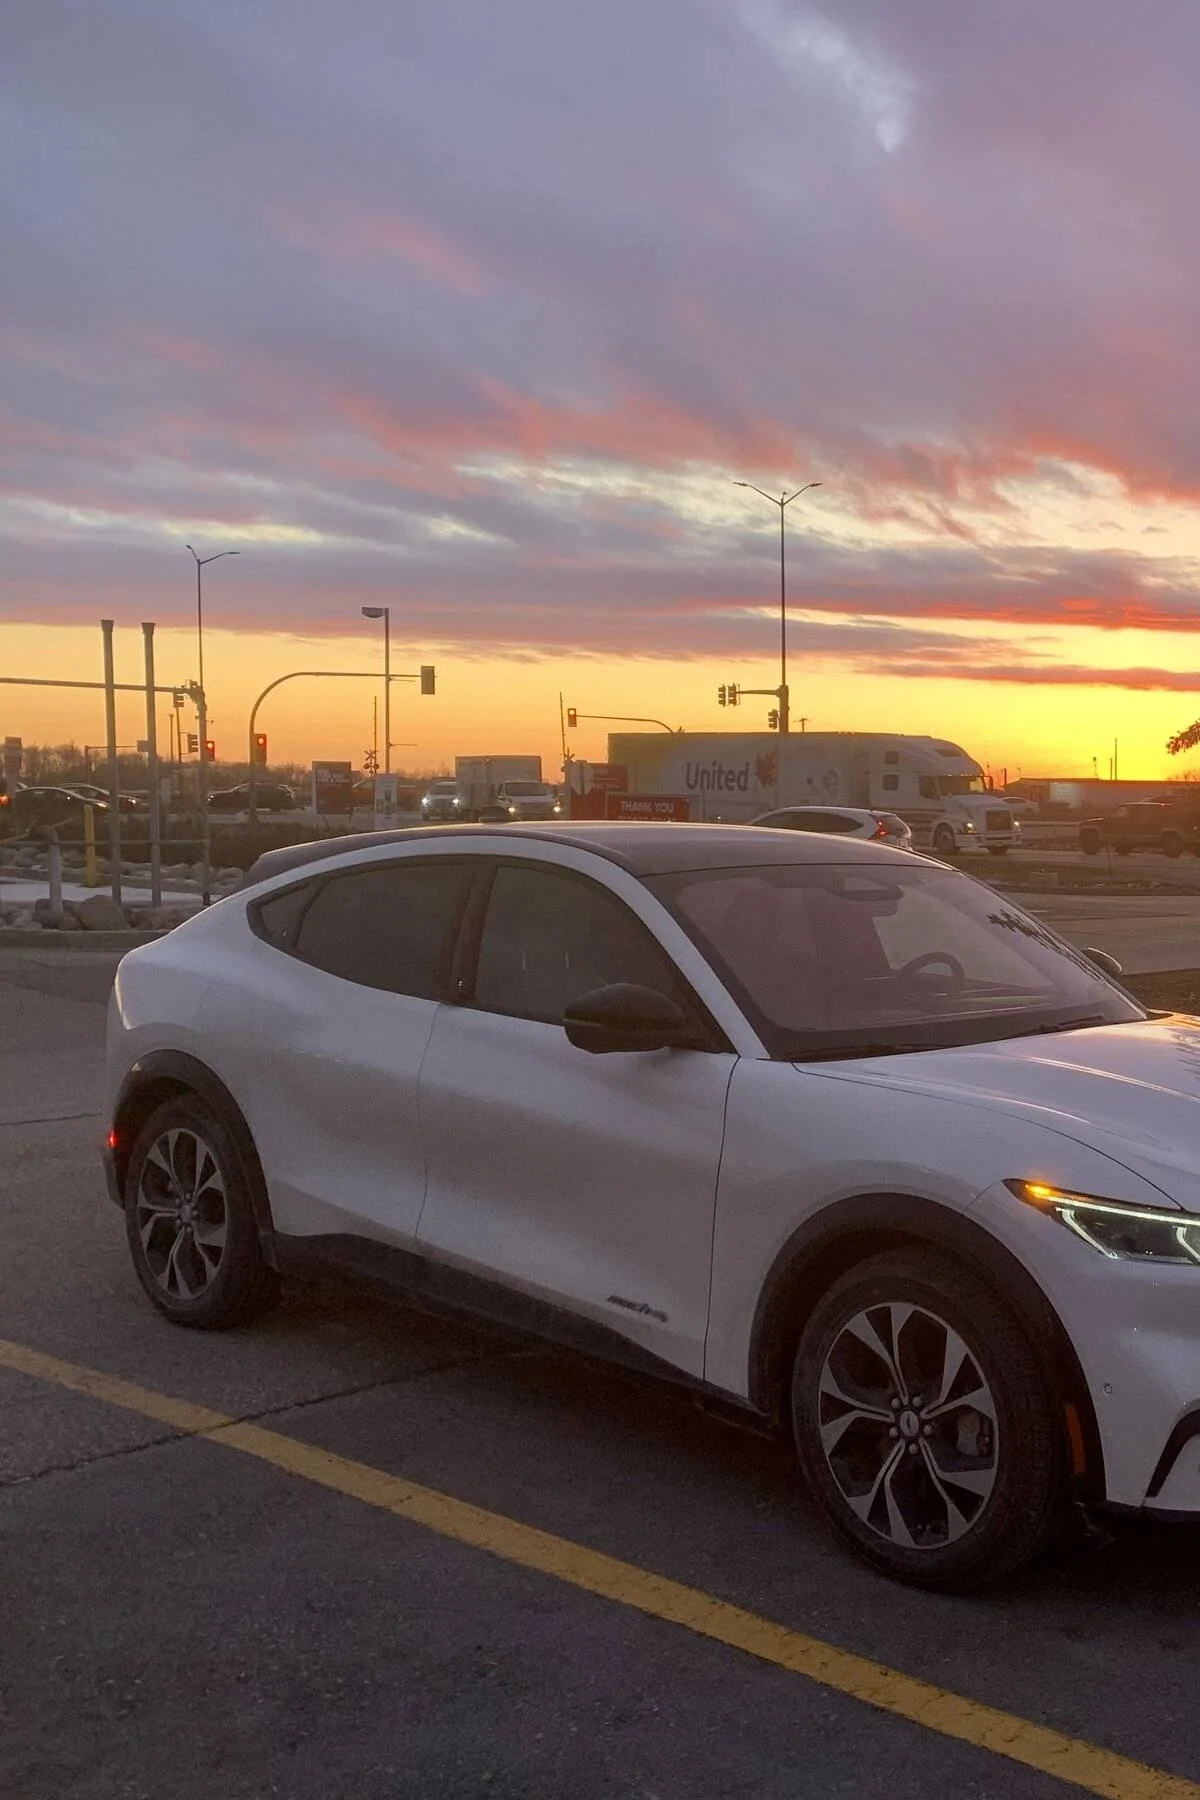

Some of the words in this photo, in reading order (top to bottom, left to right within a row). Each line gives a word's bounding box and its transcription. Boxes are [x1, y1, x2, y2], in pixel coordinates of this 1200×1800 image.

[686, 760, 749, 792] United
[621, 800, 651, 812] THANK
[654, 800, 674, 813] YOU
